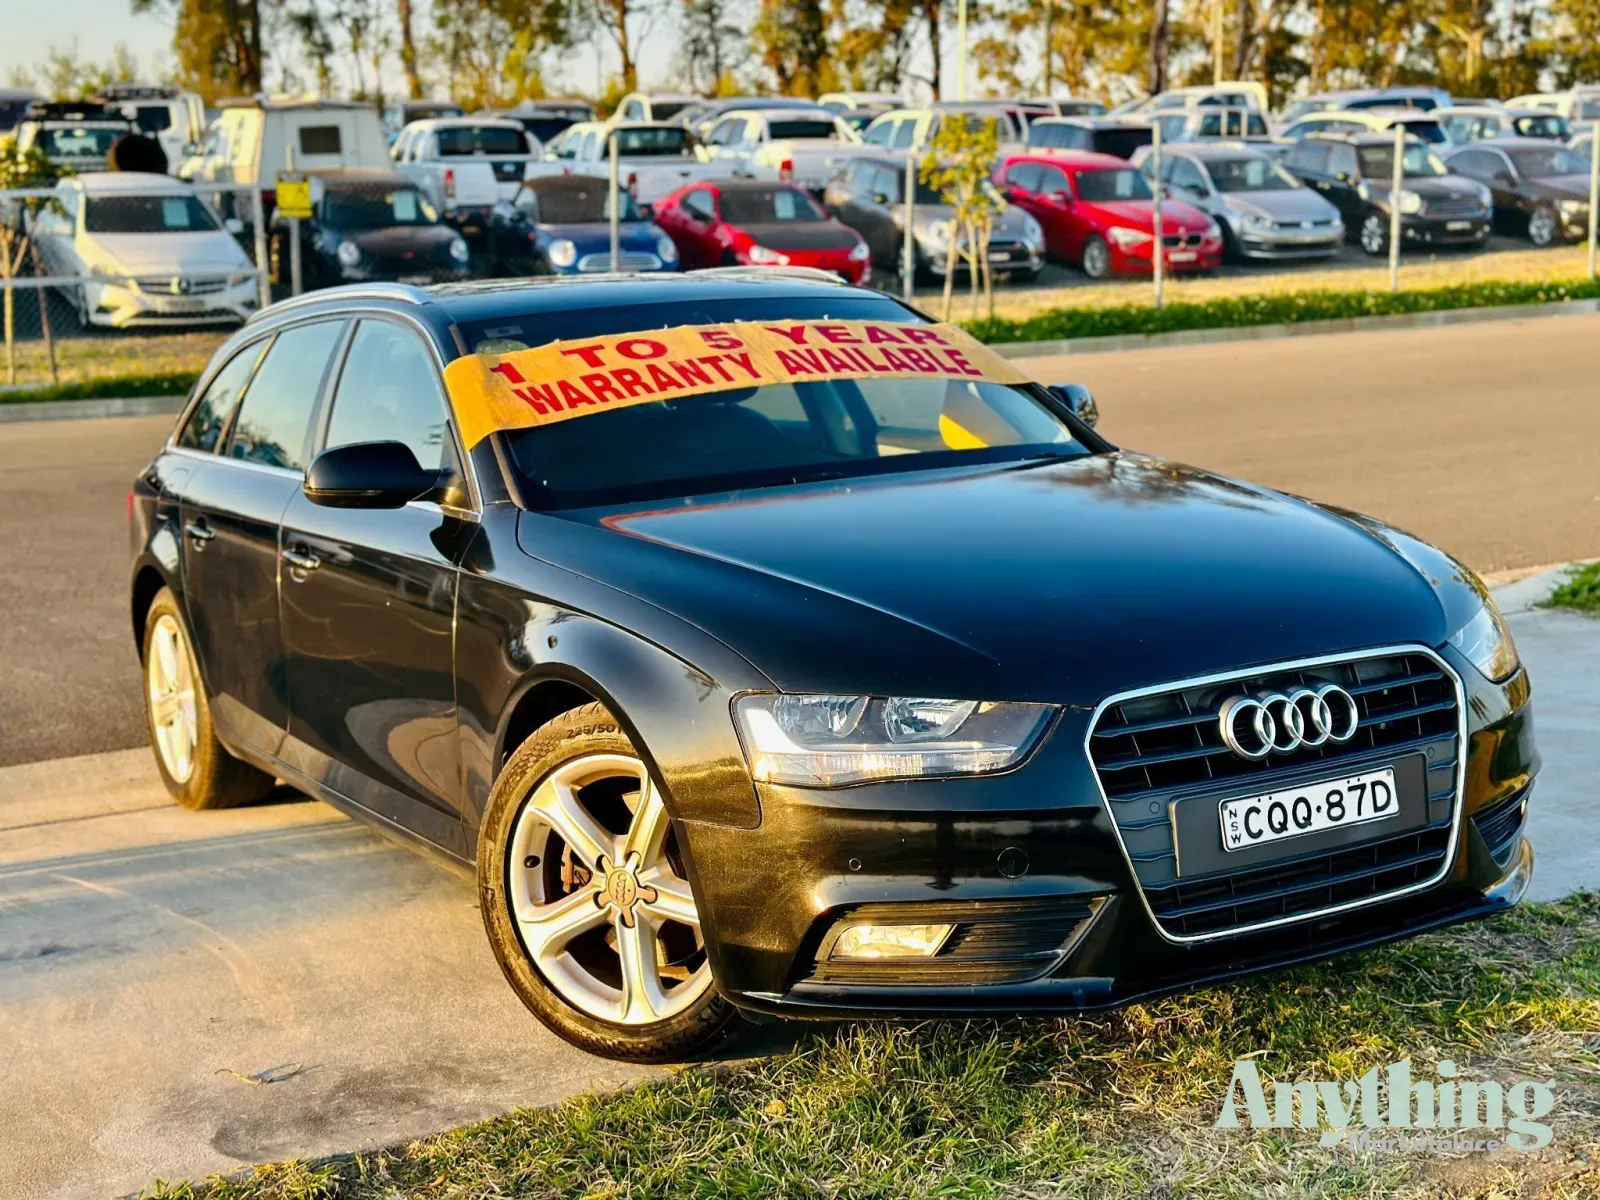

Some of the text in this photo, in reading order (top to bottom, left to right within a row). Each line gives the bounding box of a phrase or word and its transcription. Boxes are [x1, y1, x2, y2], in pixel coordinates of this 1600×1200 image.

[489, 325, 948, 385] 1 TO 5 YEAR
[512, 347, 984, 416] WARRANTY AVAILABLE
[1228, 808, 1242, 845] NSW
